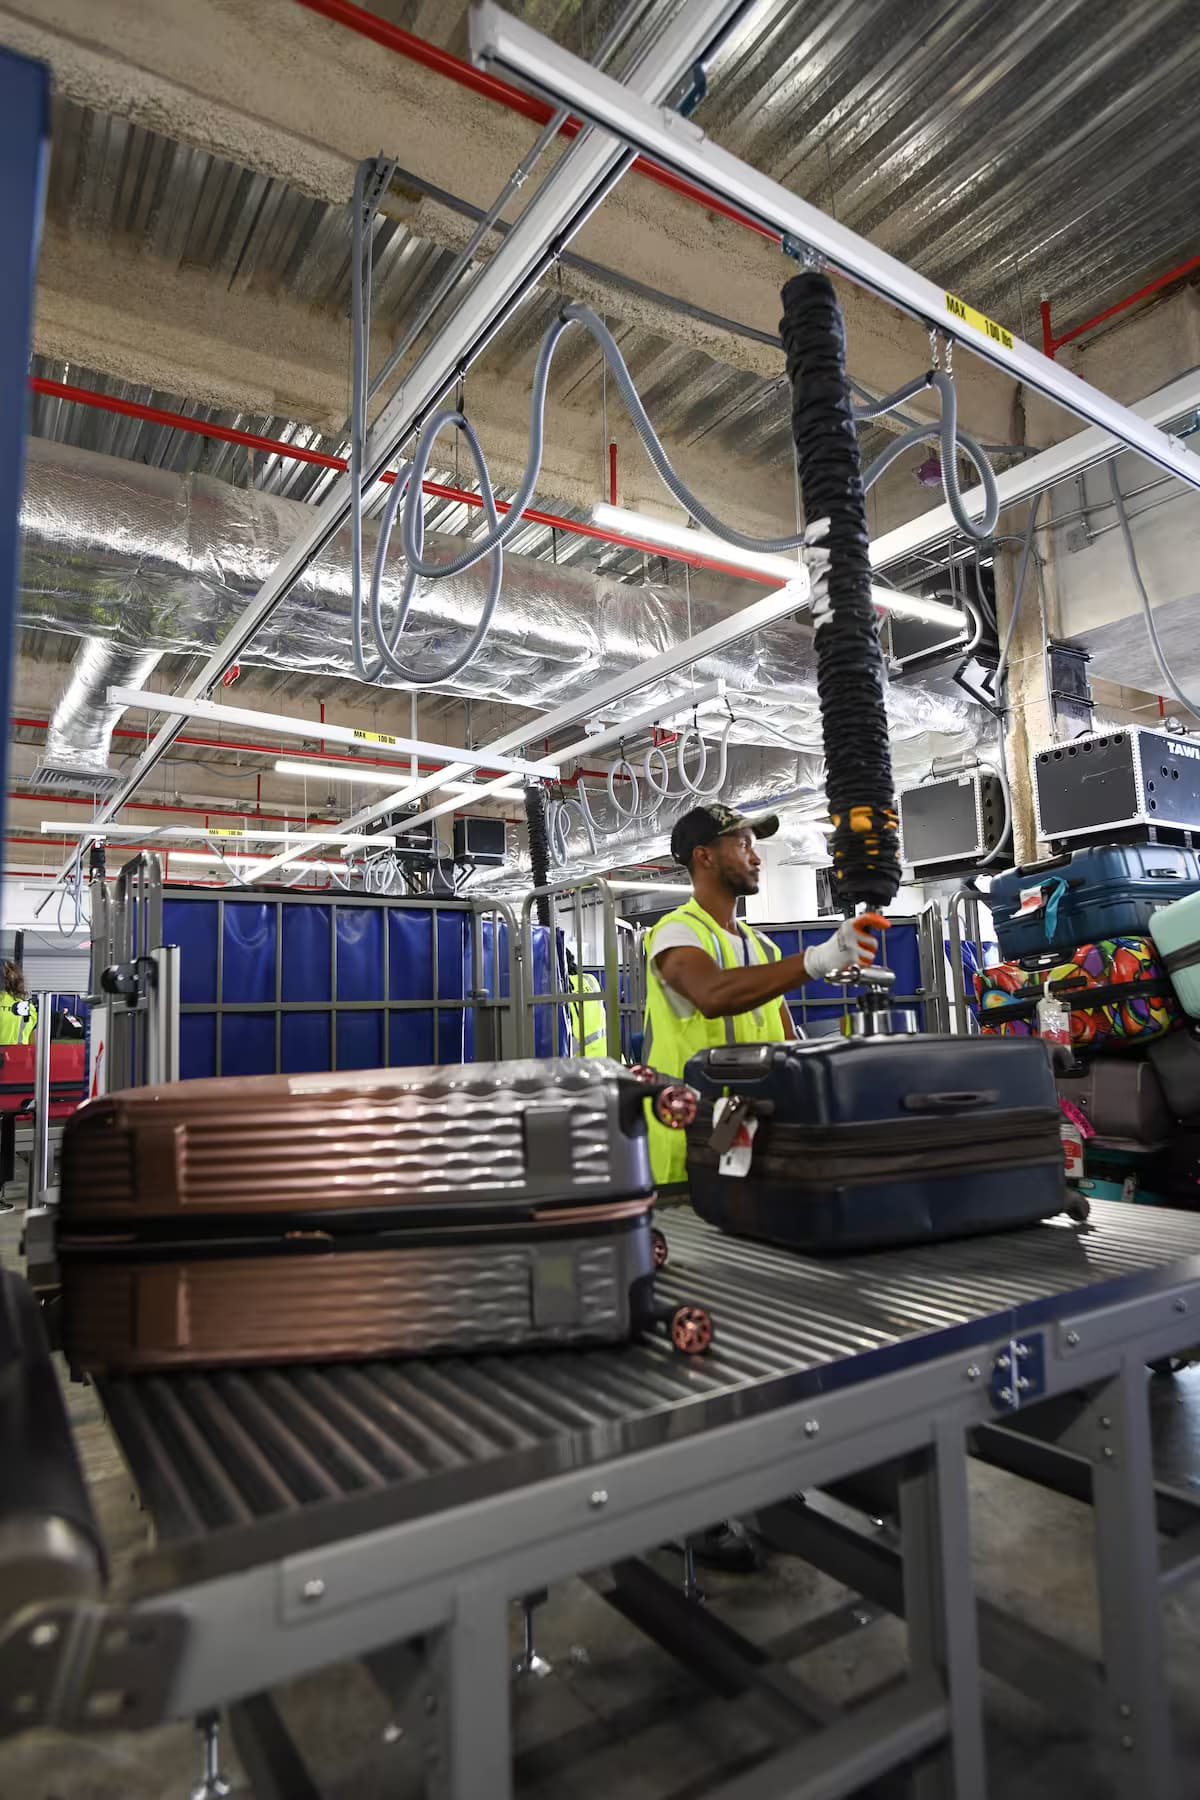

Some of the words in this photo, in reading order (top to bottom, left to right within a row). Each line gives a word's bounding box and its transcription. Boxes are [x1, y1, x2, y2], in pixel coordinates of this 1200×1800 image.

[946, 295, 966, 320] MAX
[985, 319, 1000, 341] 100
[1001, 330, 1013, 349] lbs
[353, 730, 366, 739] MAX
[378, 735, 387, 743] 100
